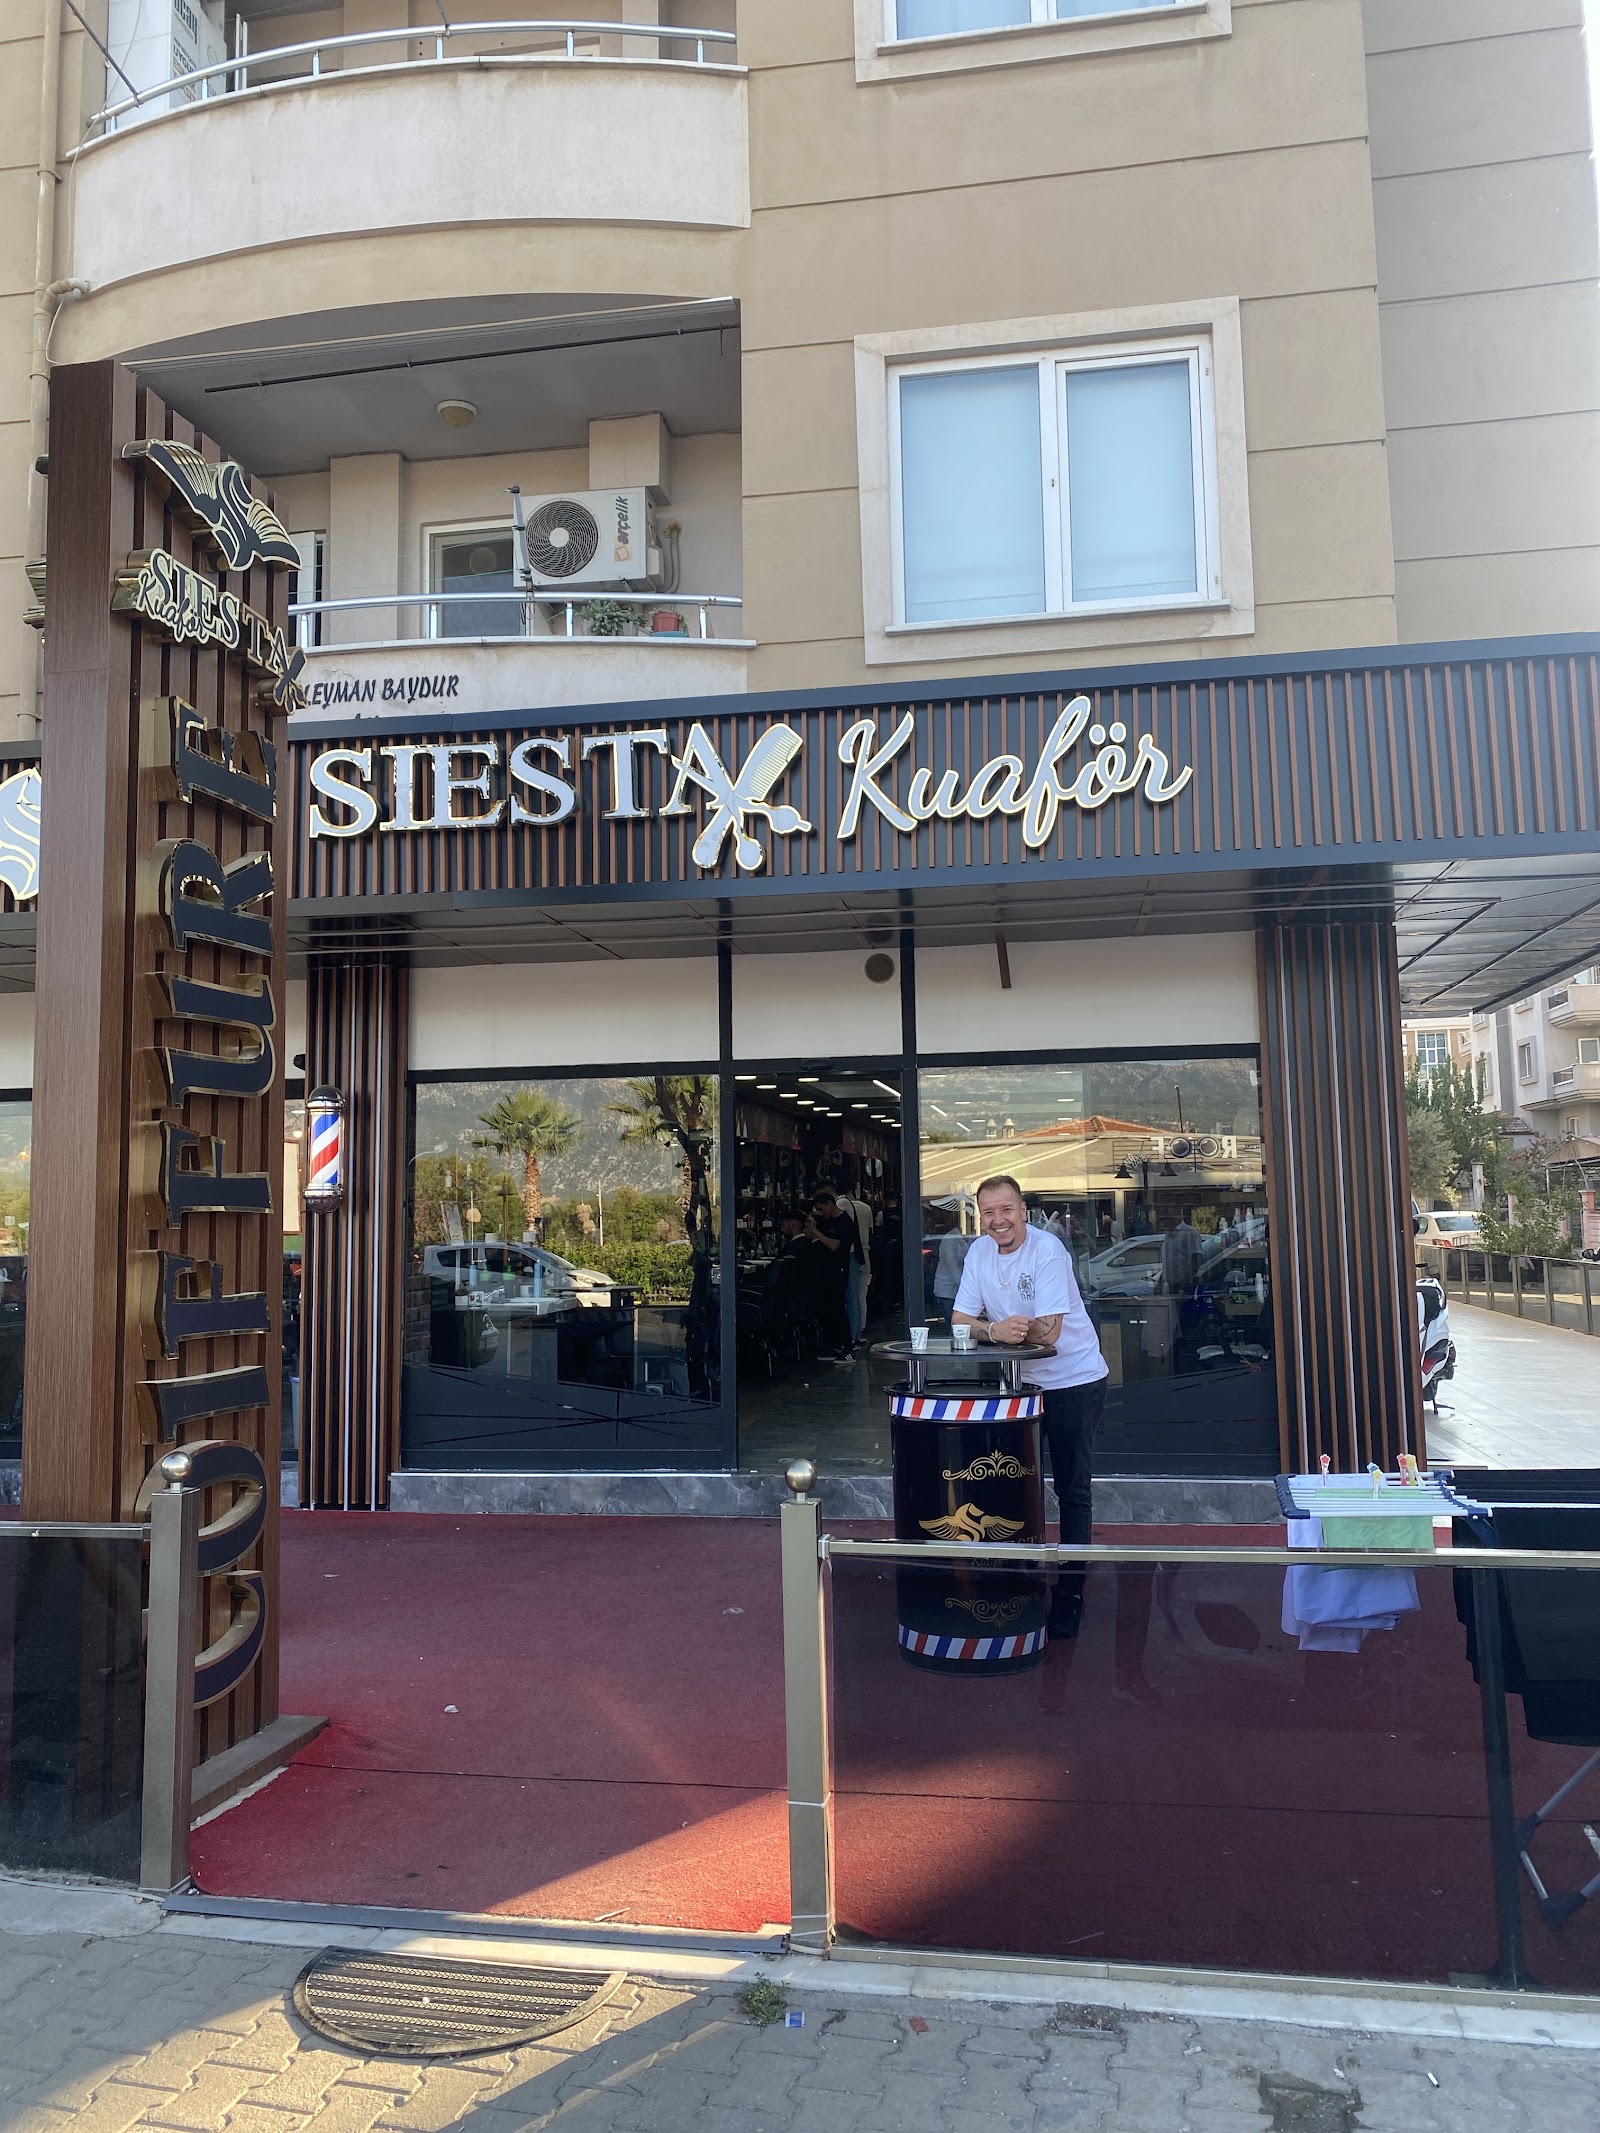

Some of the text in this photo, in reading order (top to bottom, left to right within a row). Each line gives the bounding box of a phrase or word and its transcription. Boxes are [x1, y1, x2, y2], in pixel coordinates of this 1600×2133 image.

[615, 495, 631, 545] arçelik
[137, 570, 209, 644] Kuaför
[150, 548, 290, 677] SIESTA
[303, 674, 460, 710] LEYMAN BAYDUR
[308, 695, 1193, 848] SIESTA Kuaför
